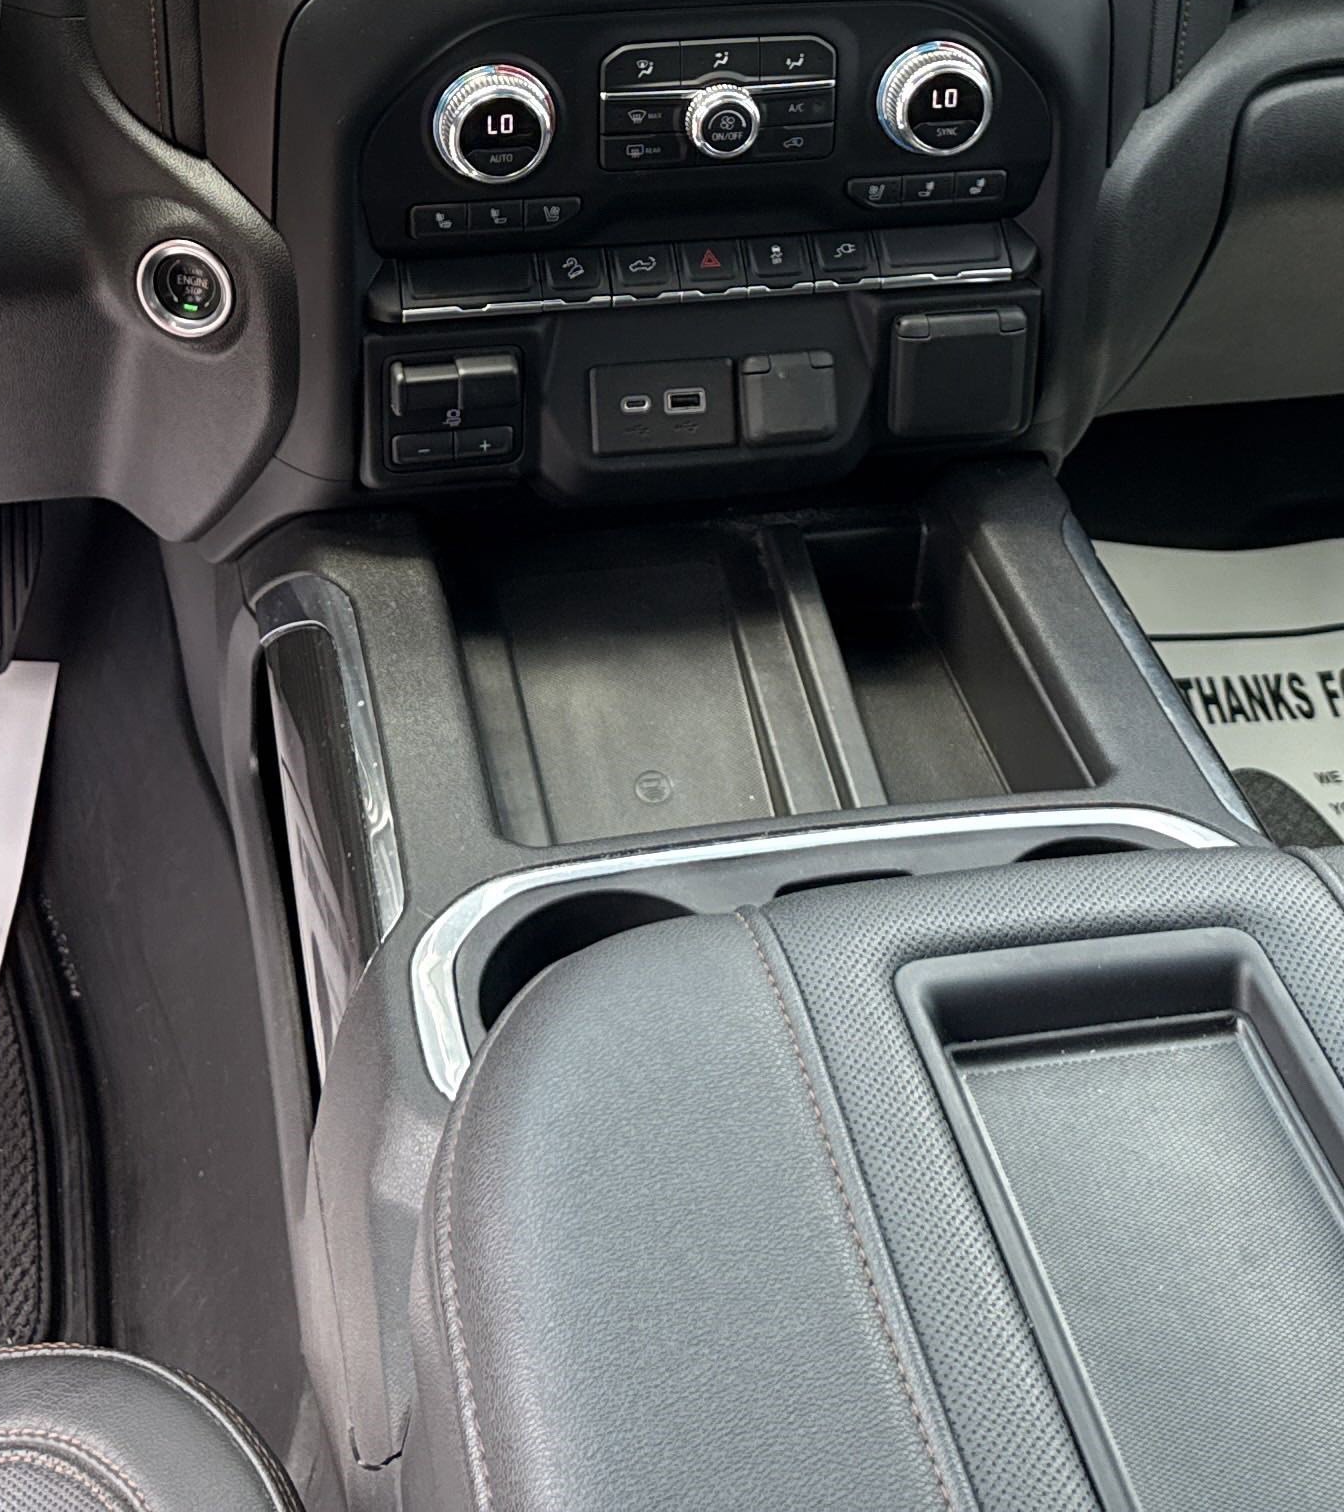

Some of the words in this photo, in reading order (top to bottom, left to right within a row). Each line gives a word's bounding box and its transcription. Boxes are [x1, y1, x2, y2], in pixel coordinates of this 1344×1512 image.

[788, 103, 804, 113] A/C
[711, 131, 743, 142] ON/OFF
[936, 127, 958, 137] SYNC
[490, 153, 513, 163] AUTO
[177, 274, 209, 290] ENGINE
[1172, 672, 1316, 725] THANKS
[1313, 770, 1344, 785] WE
